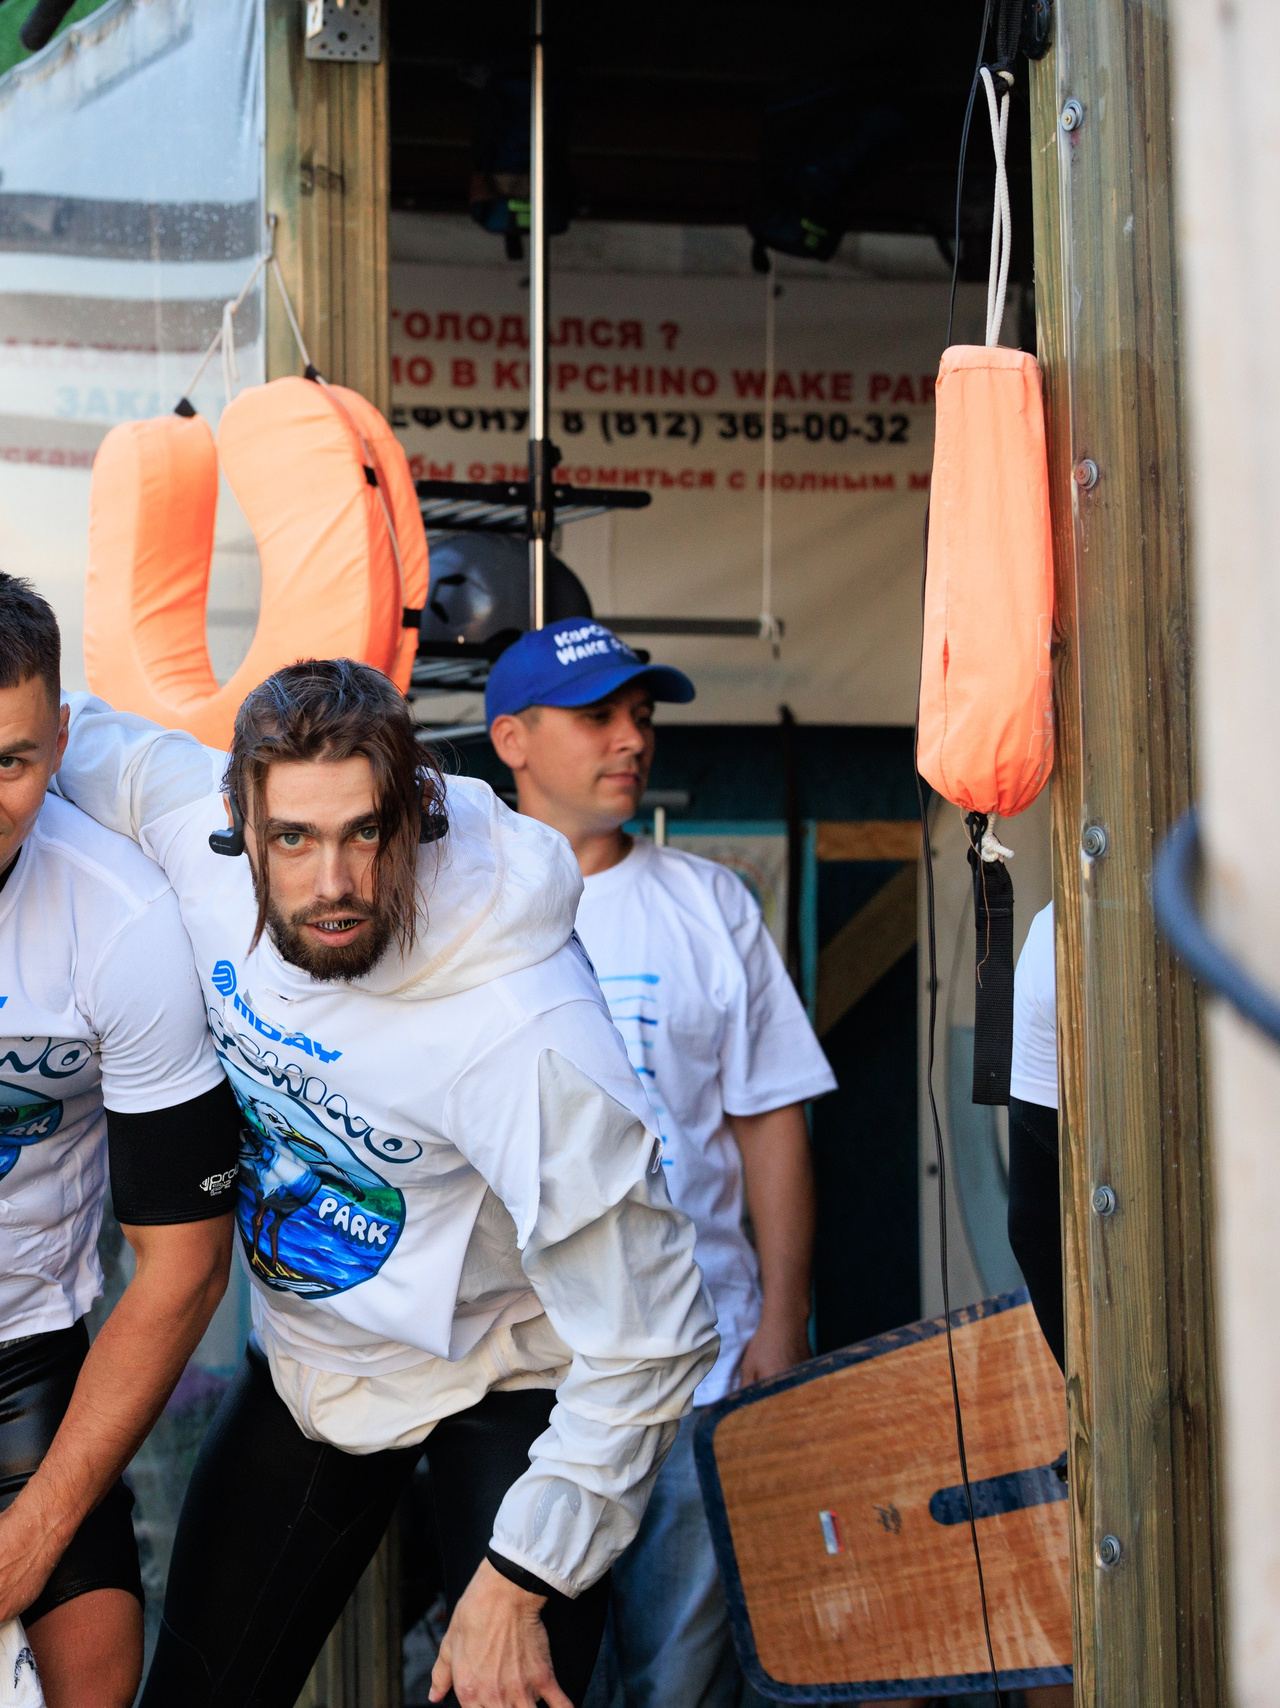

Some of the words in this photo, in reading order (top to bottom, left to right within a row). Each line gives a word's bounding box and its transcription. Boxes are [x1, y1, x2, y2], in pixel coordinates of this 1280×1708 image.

[391, 309, 644, 350] ОЛОДЛСЯ
[659, 320, 681, 350] ?
[493, 358, 718, 398] KPCHINO
[732, 368, 854, 401] WAKE
[867, 373, 937, 405] PAR
[391, 406, 530, 432] ЕФОНУ
[601, 411, 702, 445] (812)
[467, 460, 716, 491] ознкомиться
[317, 1196, 392, 1249] PARK
